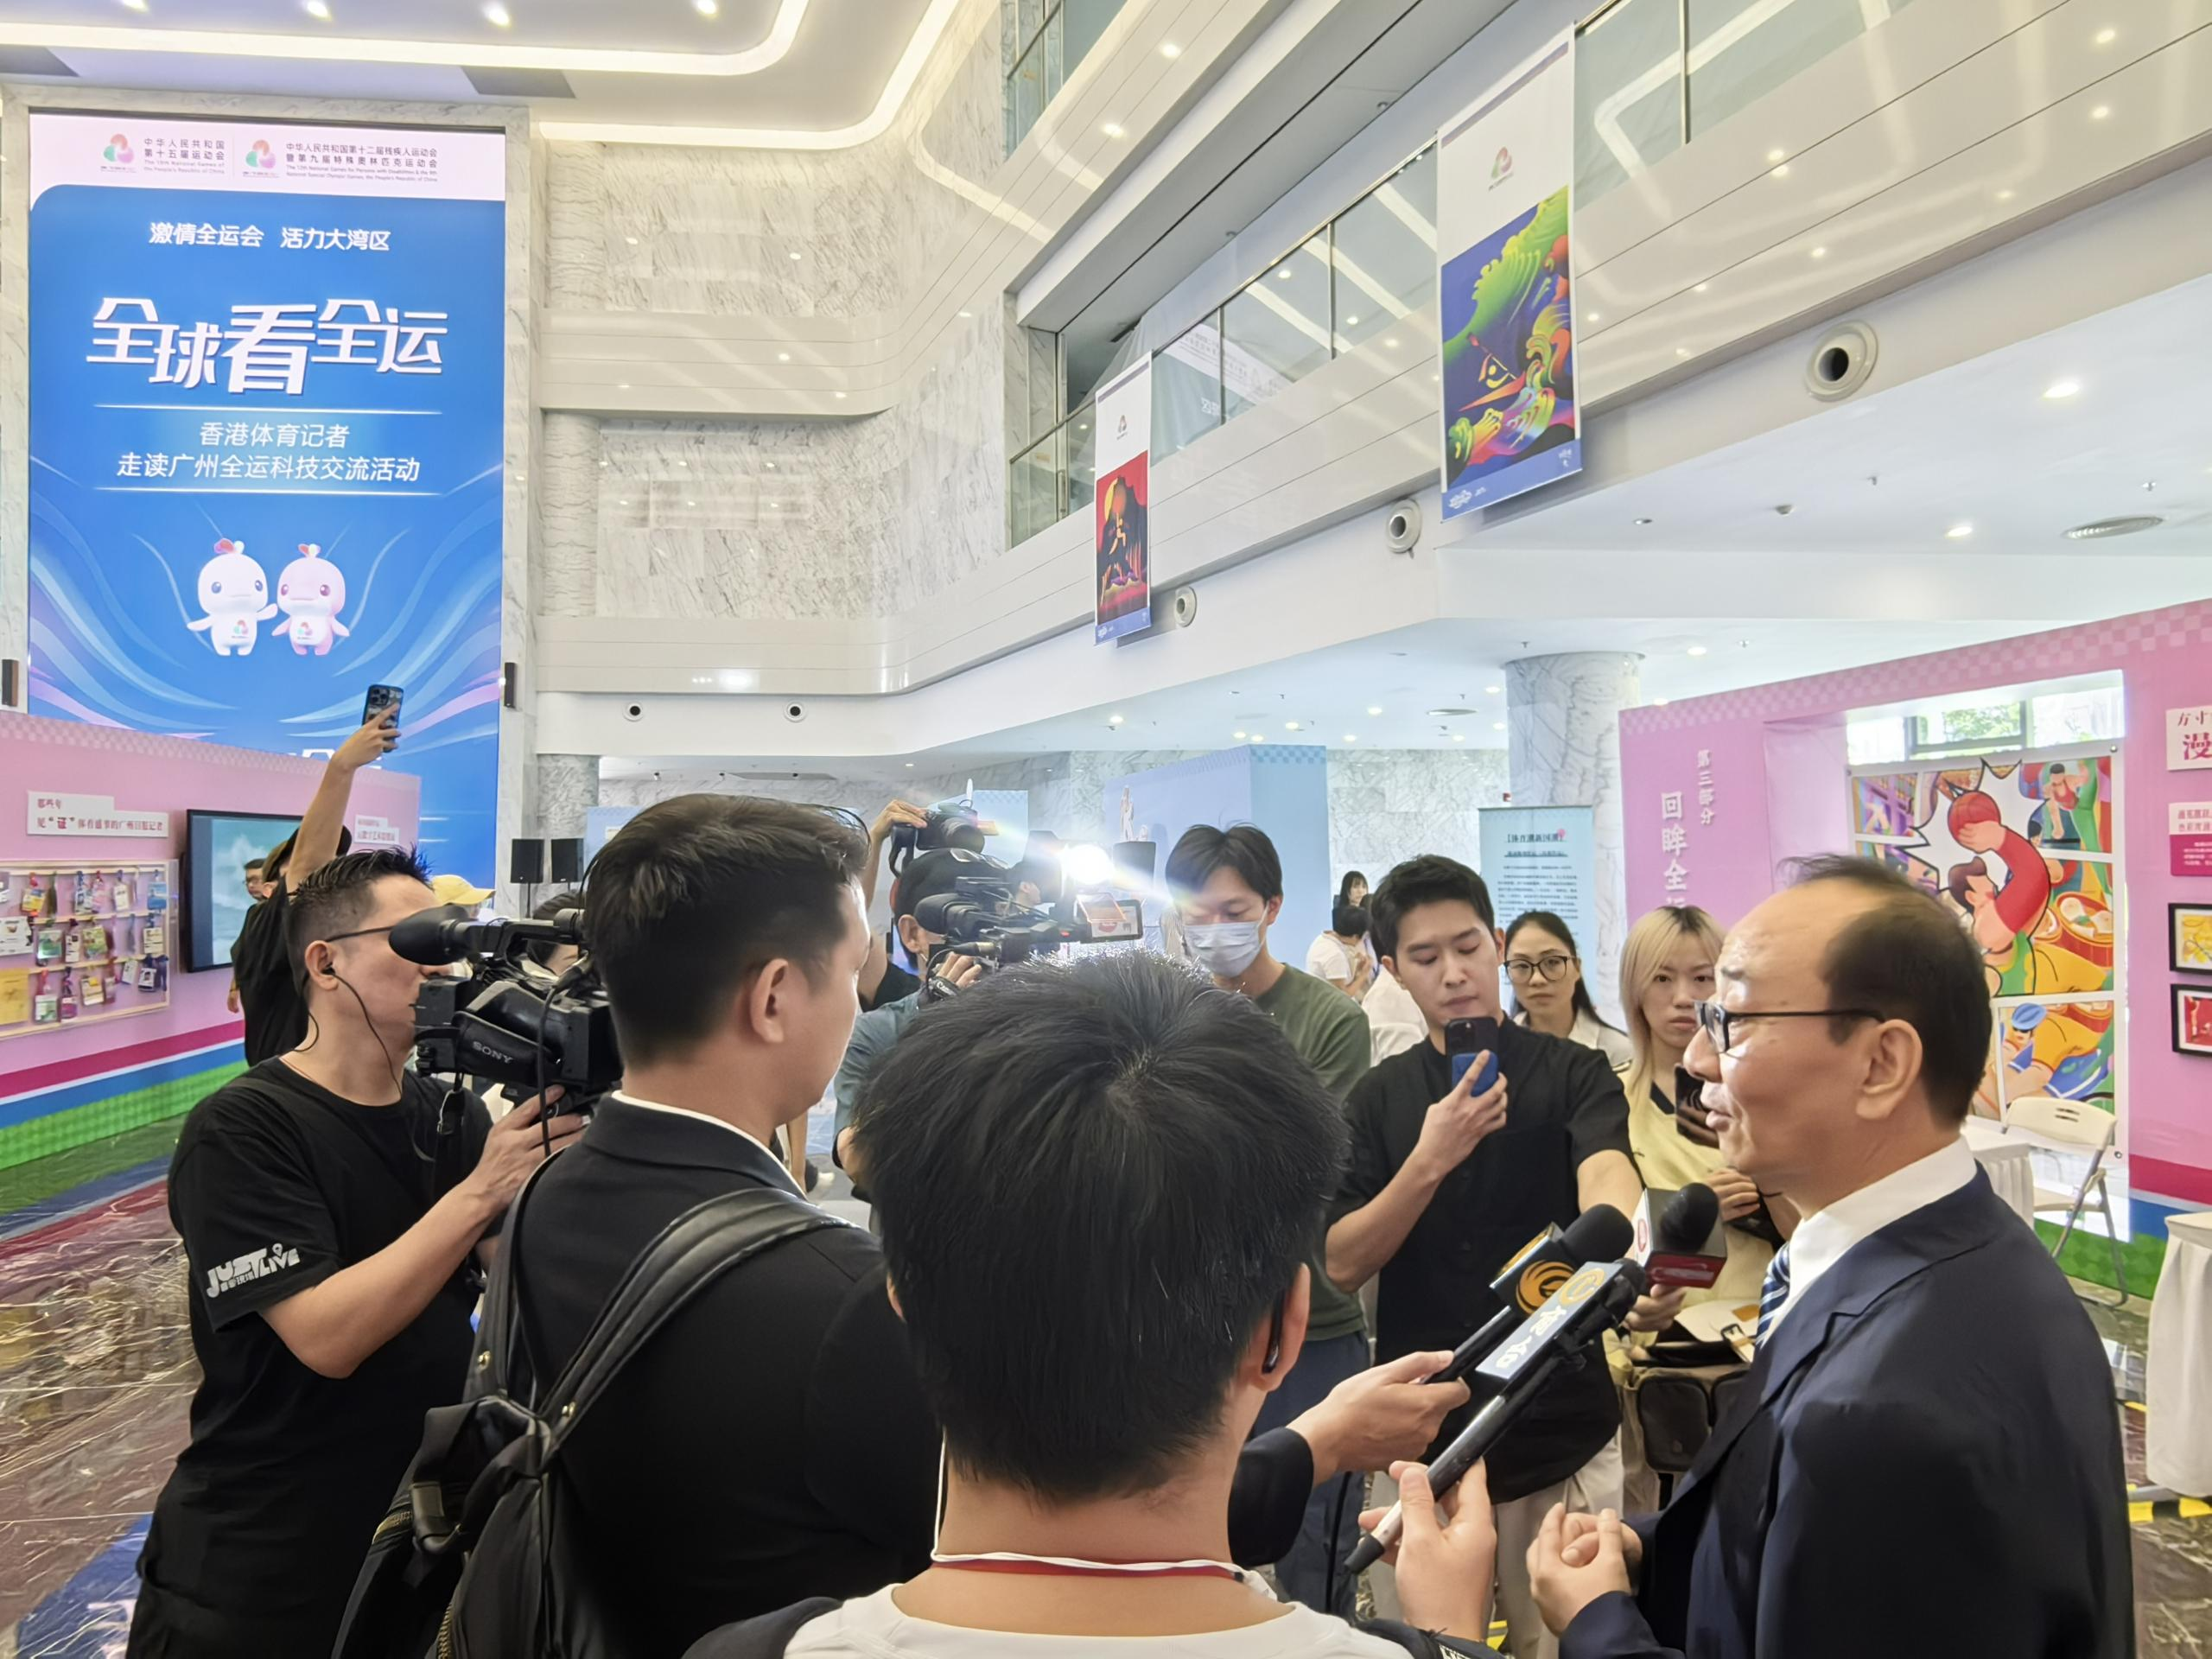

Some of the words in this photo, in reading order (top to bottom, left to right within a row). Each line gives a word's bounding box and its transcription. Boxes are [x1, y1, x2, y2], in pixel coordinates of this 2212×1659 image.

[143, 138, 225, 149] 中华人民共和国
[143, 149, 225, 161] 第十五届运动会
[286, 143, 437, 157] 中华人民共和国第十二届残疾人运动会
[149, 222, 264, 248] 激情全运会
[280, 226, 391, 251] 活力大湾区
[86, 297, 448, 395] 全球看全运
[200, 422, 350, 448] 香港体育记者
[117, 452, 421, 482] 走读广州全运科技交流活动
[1697, 749, 1714, 824] 第三部分
[473, 1041, 513, 1064] SONY
